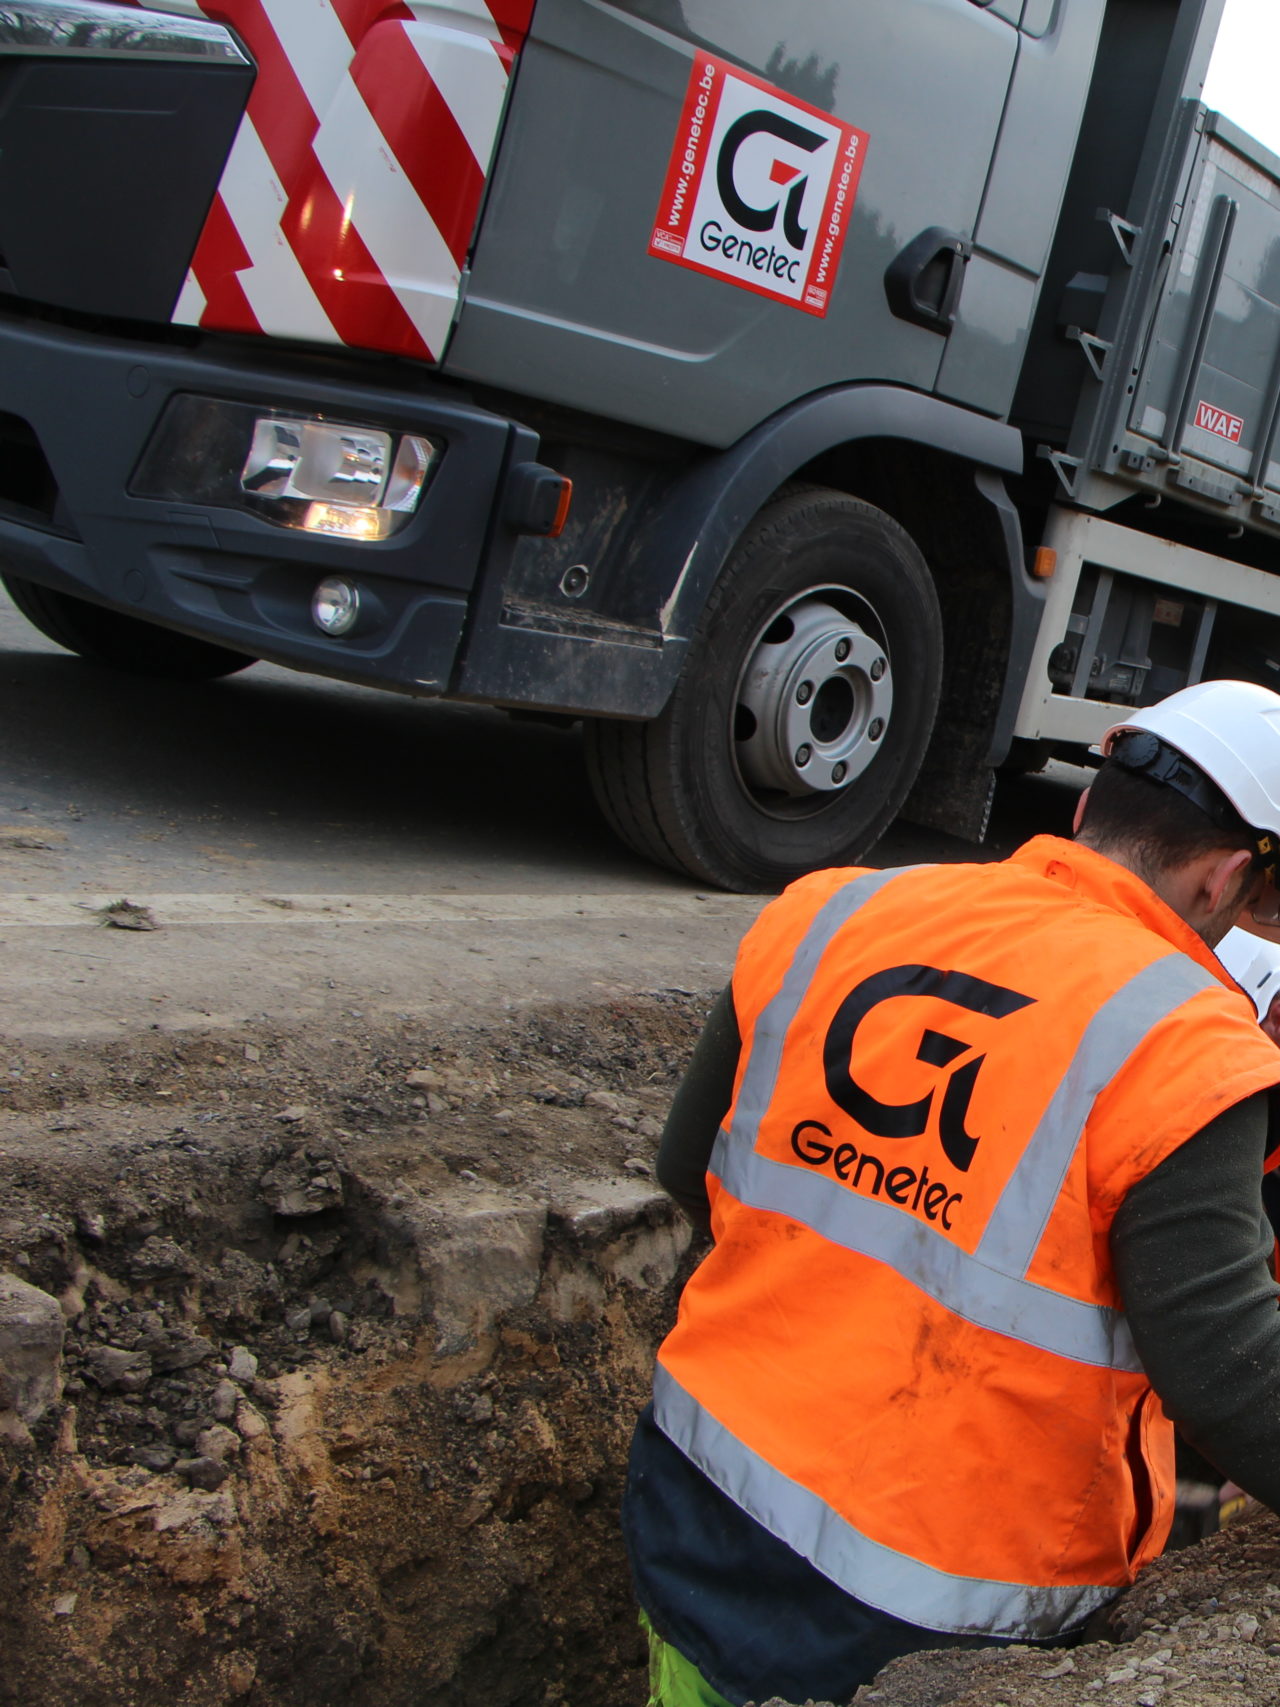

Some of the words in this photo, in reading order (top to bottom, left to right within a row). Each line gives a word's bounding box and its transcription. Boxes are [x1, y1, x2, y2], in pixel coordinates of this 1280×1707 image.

[668, 63, 715, 227] www.genetec.be
[699, 220, 801, 284] Genetec
[815, 134, 859, 284] www.genetec.be
[1200, 405, 1241, 438] WAF
[790, 1119, 963, 1231] Genetec
